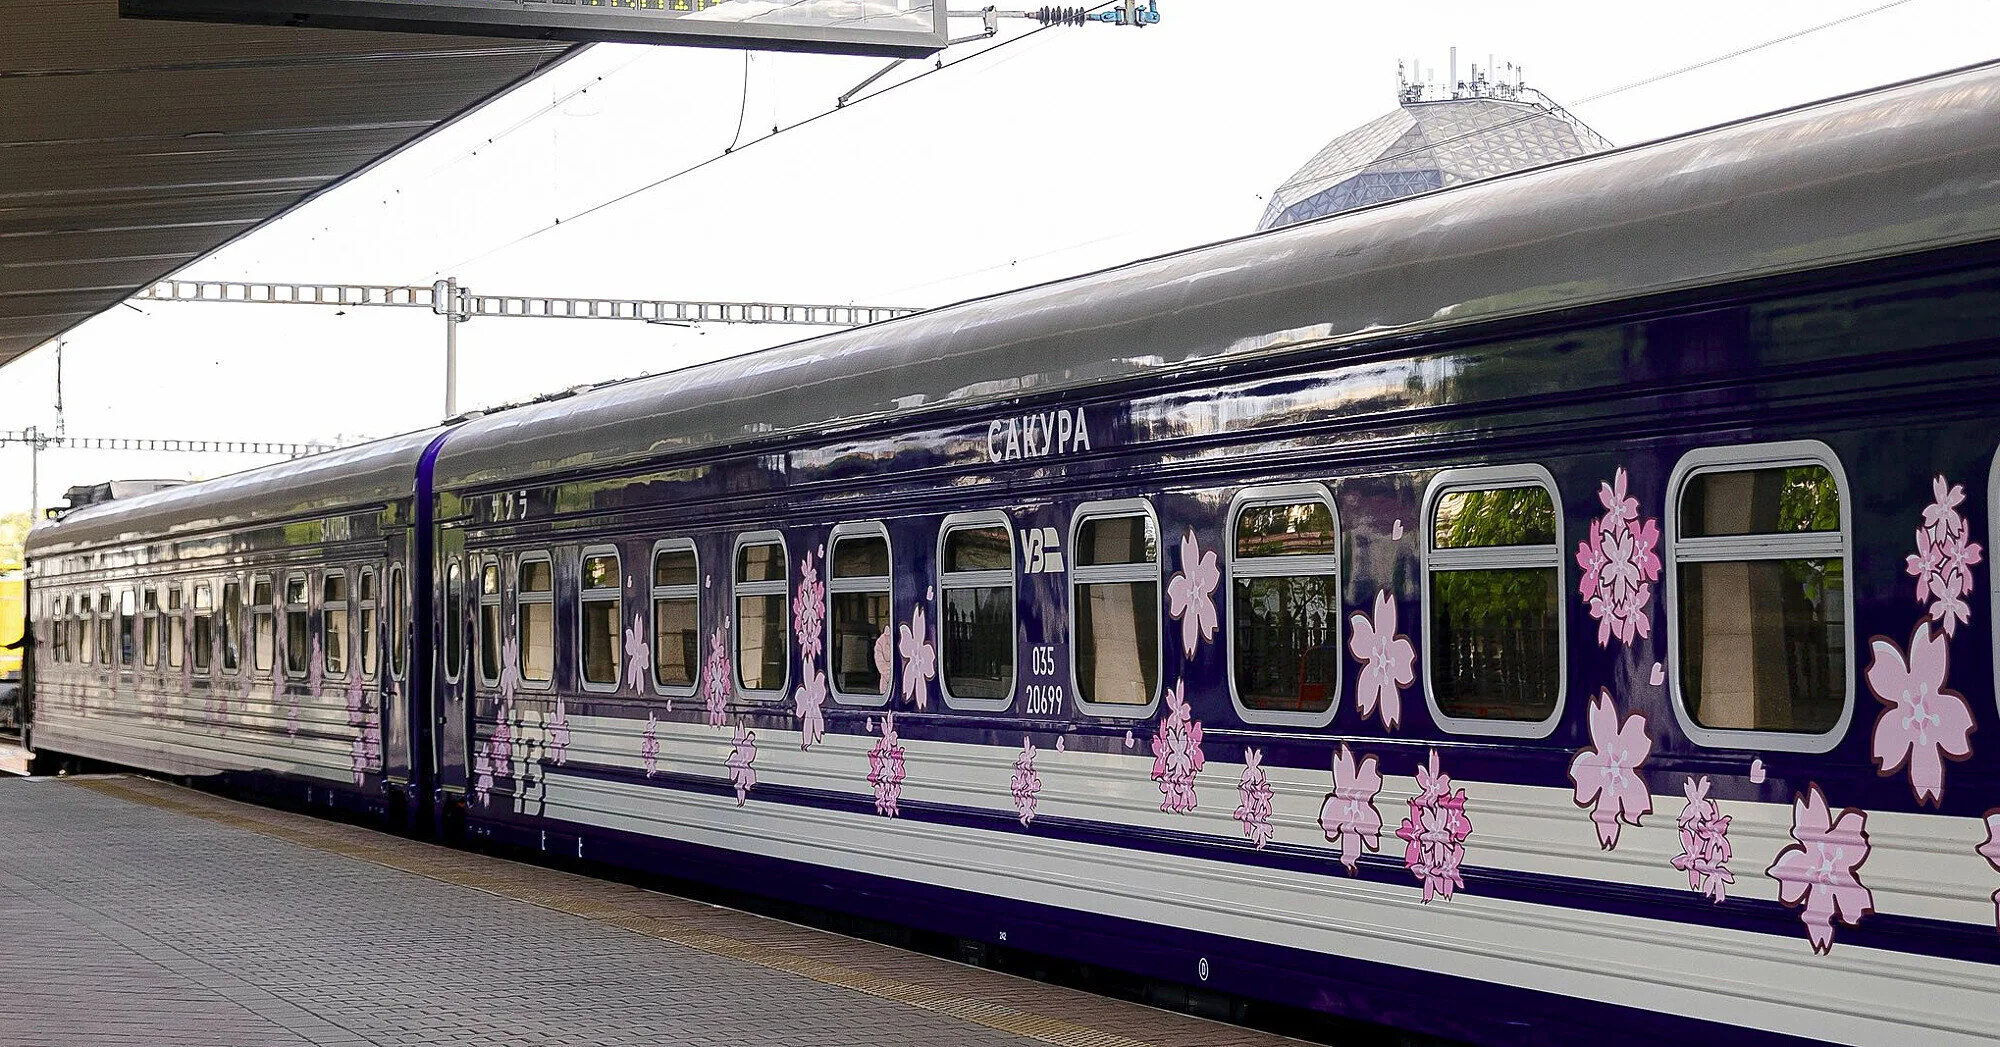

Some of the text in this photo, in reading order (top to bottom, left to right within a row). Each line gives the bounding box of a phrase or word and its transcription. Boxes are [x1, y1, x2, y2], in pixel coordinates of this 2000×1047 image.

[987, 406, 1091, 463] САКУРА
[492, 490, 527, 522] サクラ
[1032, 646, 1055, 676] 035
[1025, 685, 1064, 715] 20699
